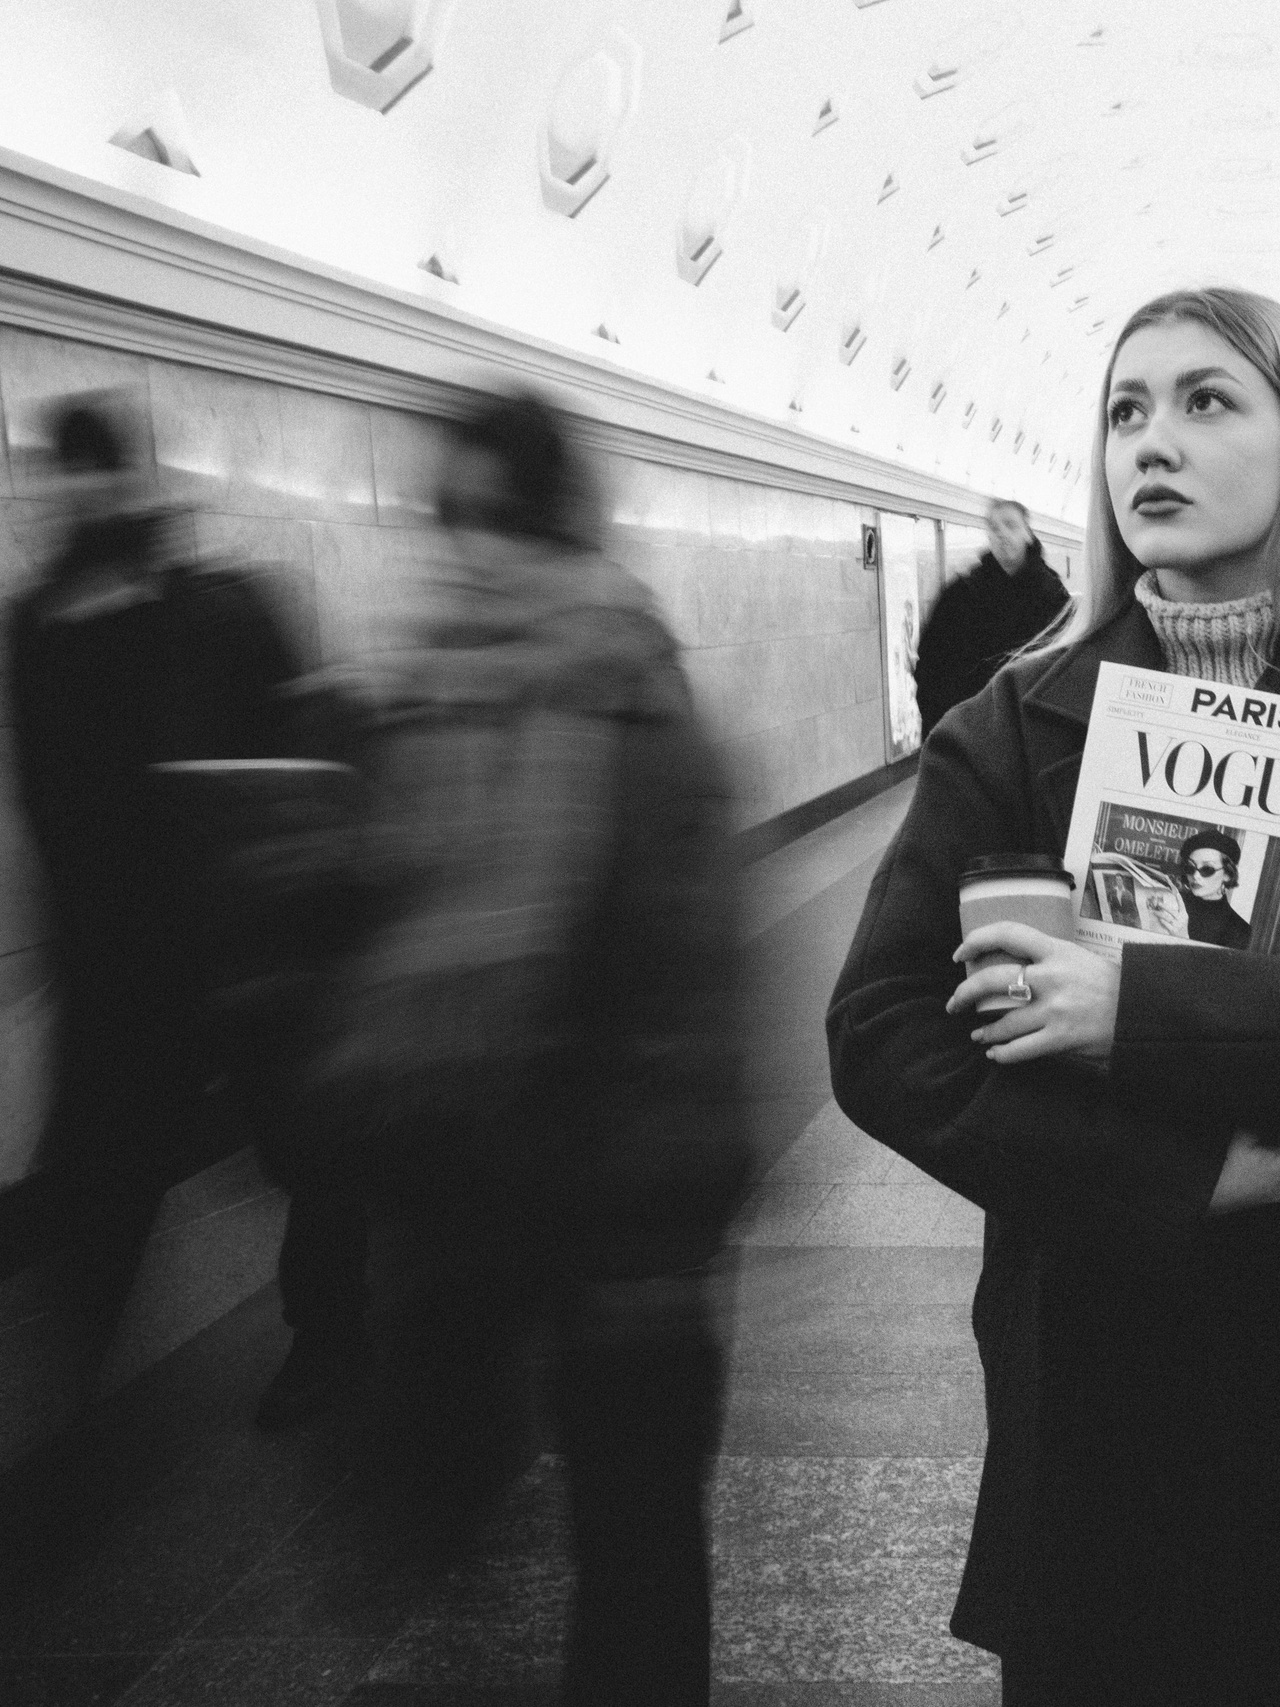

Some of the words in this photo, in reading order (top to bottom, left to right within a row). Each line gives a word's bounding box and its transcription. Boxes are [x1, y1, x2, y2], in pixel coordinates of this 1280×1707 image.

[1128, 677, 1167, 693] FRENCH
[1125, 689, 1165, 704] FASHION
[1225, 728, 1261, 741] ELEGANCE
